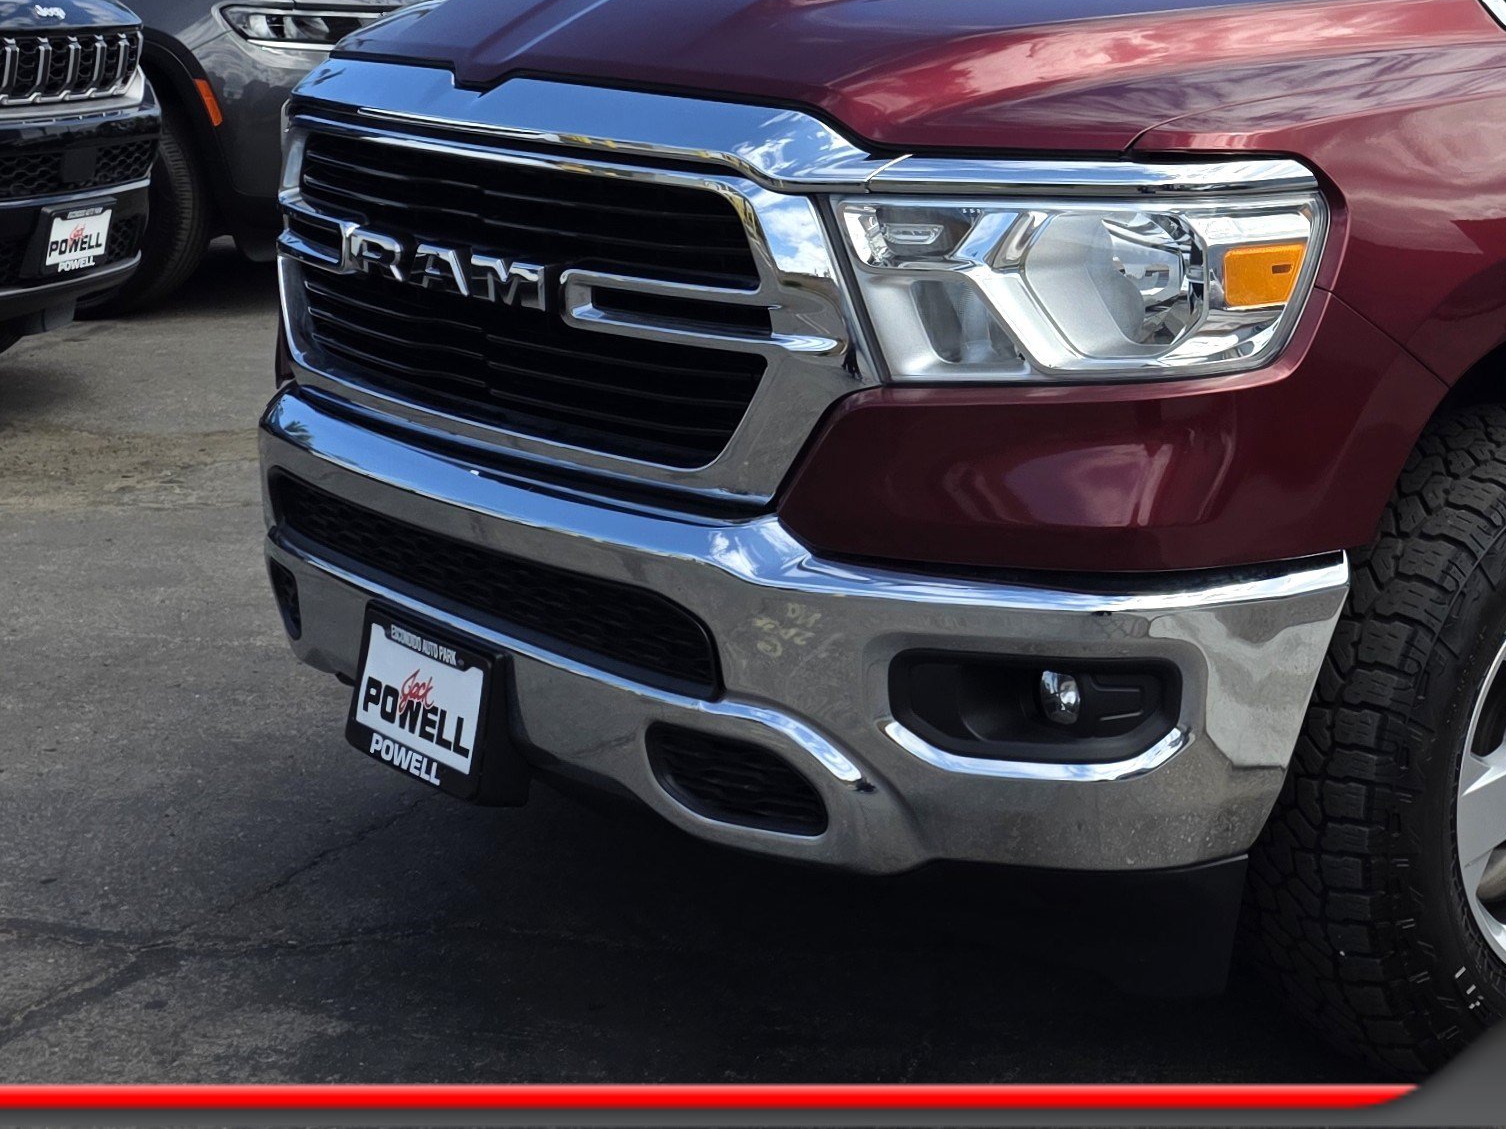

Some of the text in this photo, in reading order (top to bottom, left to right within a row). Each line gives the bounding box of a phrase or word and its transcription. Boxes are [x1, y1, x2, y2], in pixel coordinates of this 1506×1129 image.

[48, 231, 102, 258] POWELL
[57, 256, 96, 273] POWELL
[350, 227, 547, 313] RAM
[422, 639, 439, 660] AUTO
[439, 645, 457, 667] PARK
[399, 668, 435, 714] Jack
[362, 676, 471, 759] POWELL
[369, 732, 441, 787] POWELL
